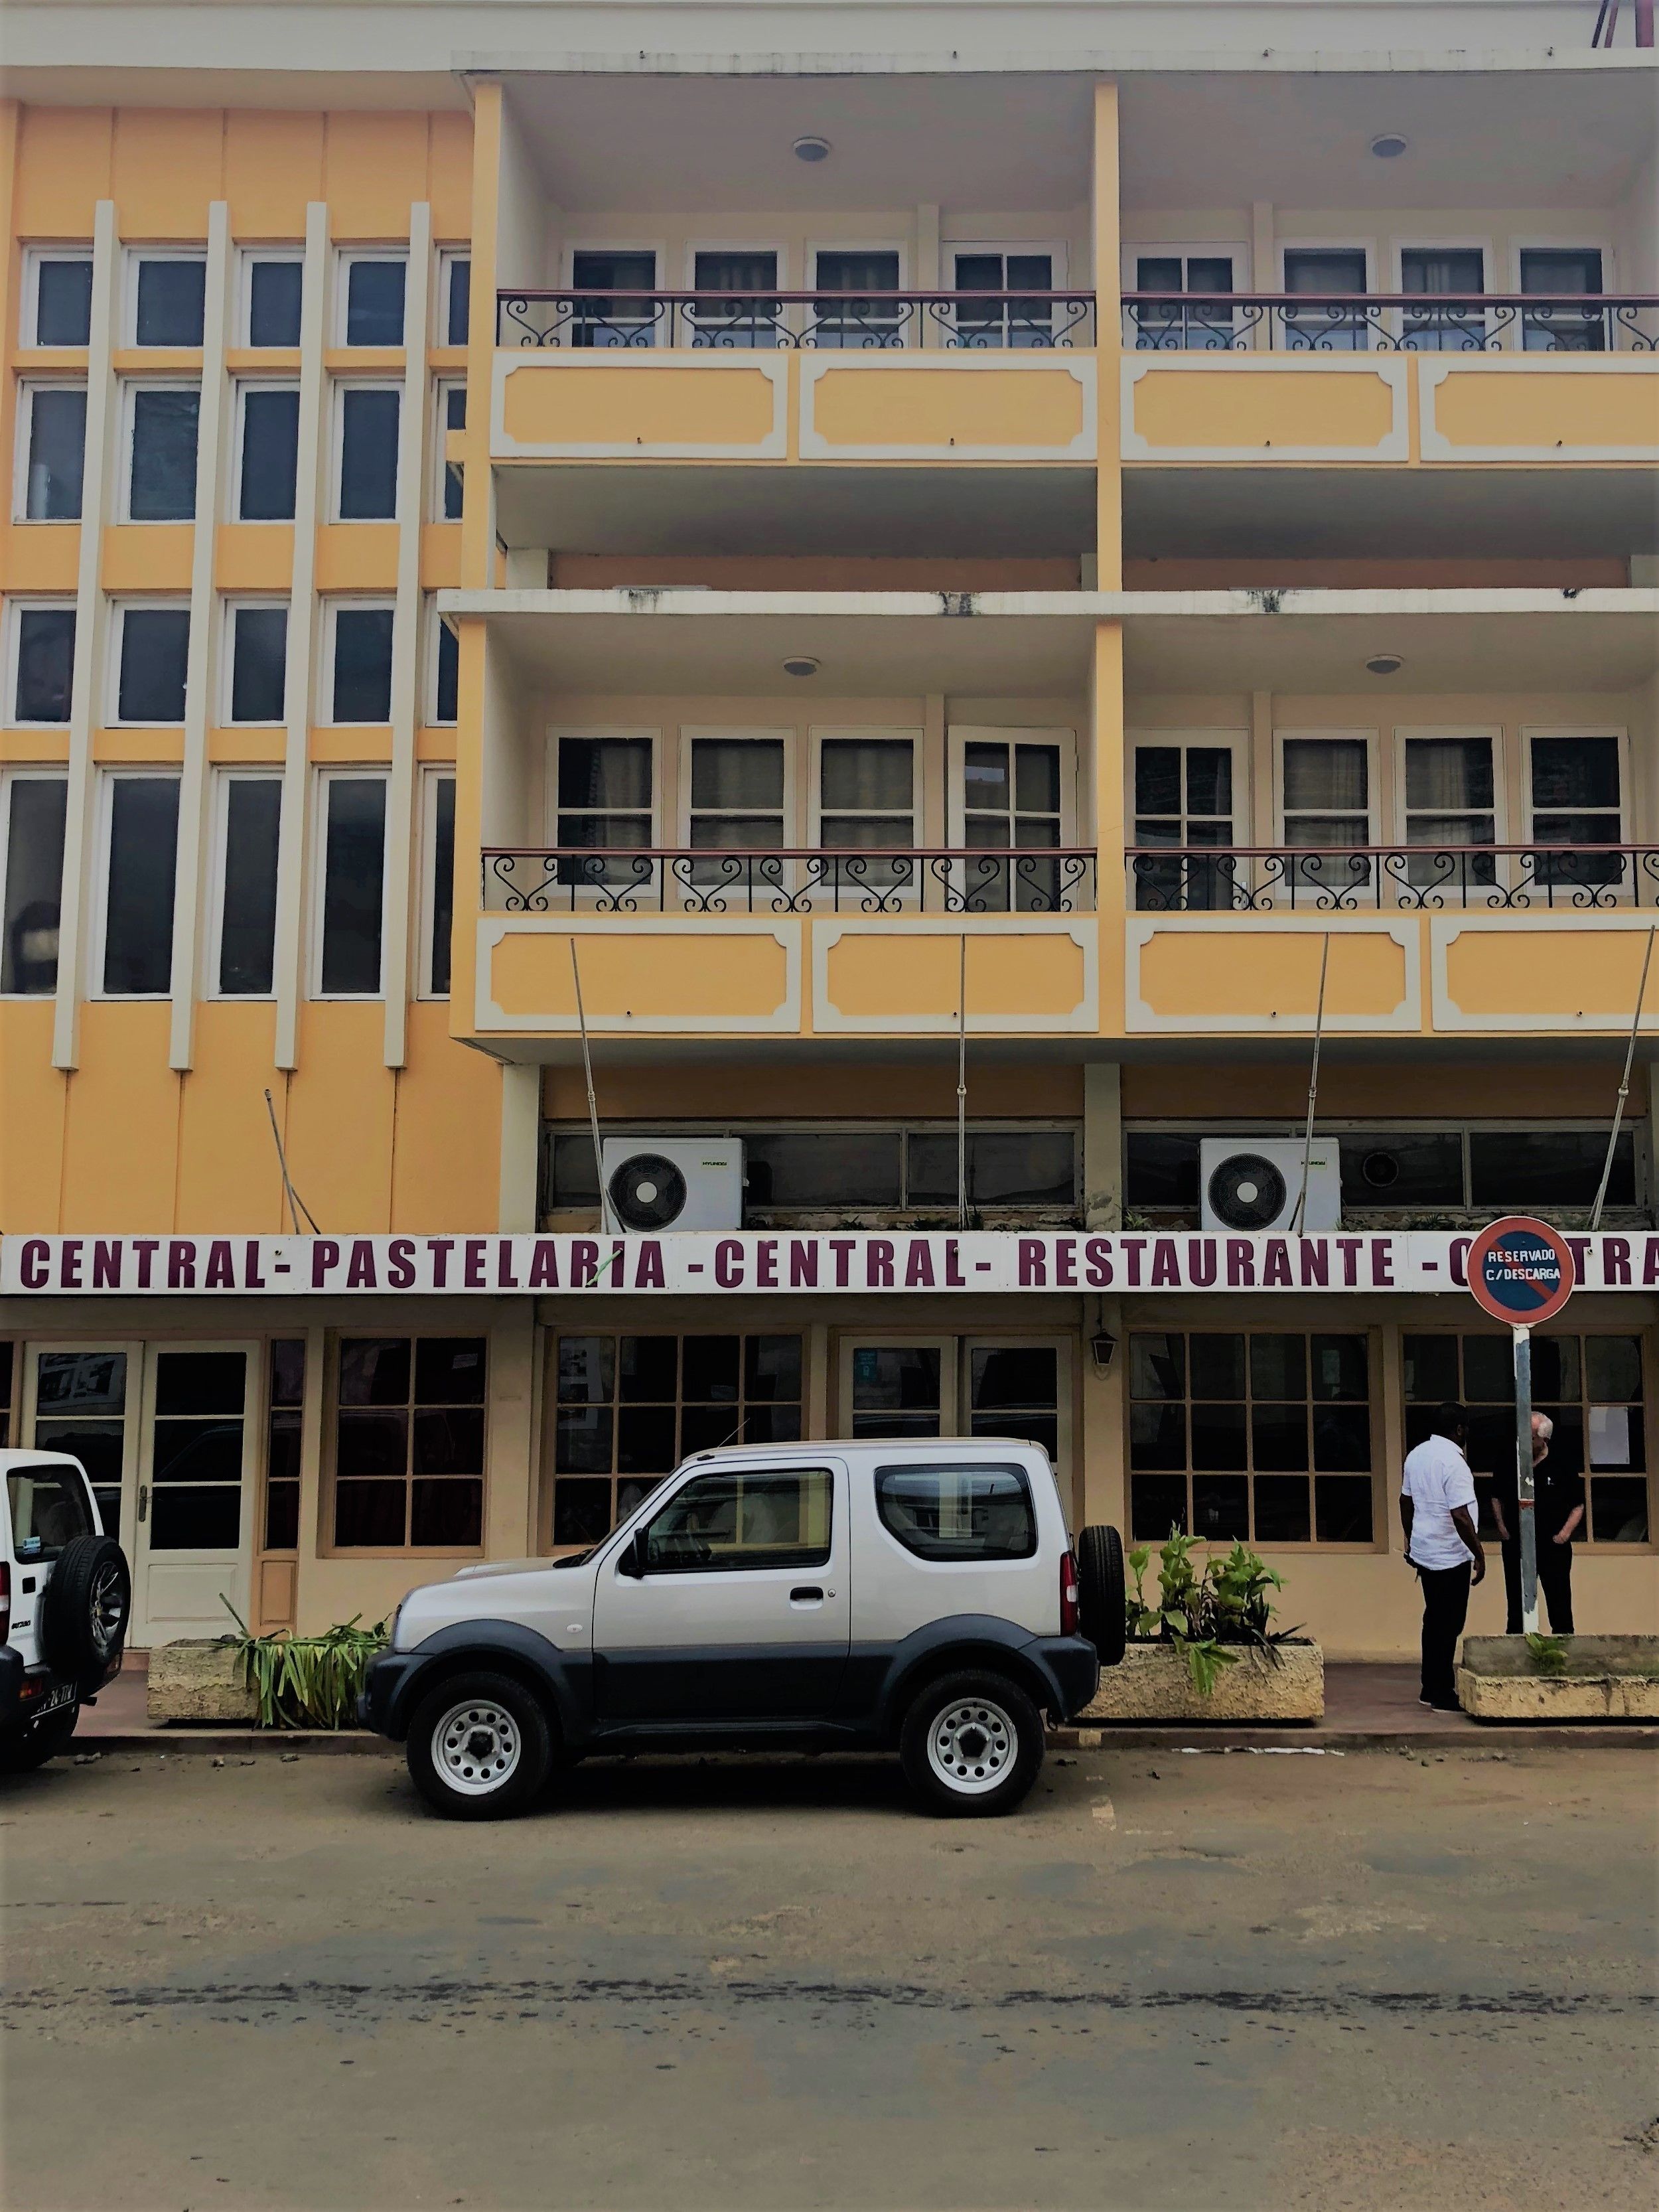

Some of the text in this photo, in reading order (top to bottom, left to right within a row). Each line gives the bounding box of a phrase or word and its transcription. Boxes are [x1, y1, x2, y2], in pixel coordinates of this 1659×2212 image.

[1488, 1248, 1555, 1262] RESERVADO
[311, 1239, 666, 1288] PASTELARIA
[1018, 1238, 1395, 1287] RESTAURANTE
[1485, 1268, 1561, 1281] C/DESCARGA
